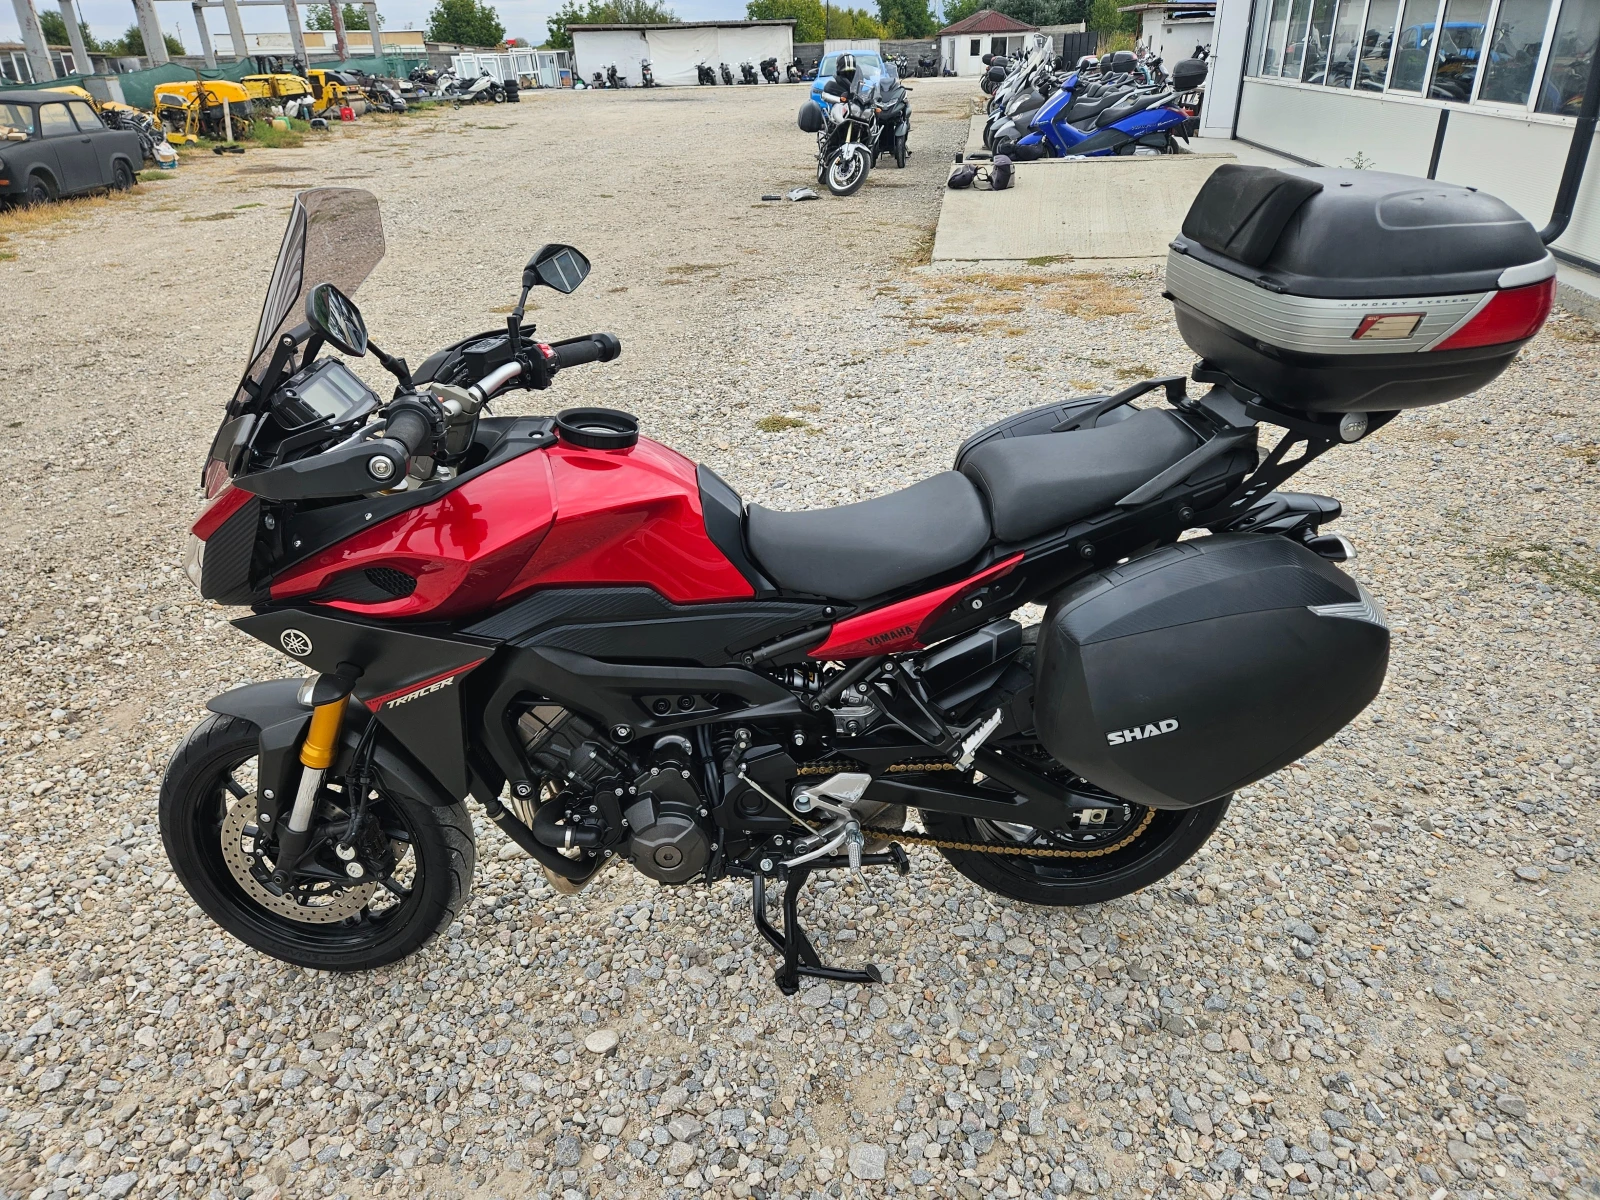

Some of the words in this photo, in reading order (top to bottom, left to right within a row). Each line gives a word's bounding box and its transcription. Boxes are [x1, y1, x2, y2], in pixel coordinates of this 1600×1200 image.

[866, 625, 914, 646] YAMAHA
[386, 676, 454, 709] TRACER
[1107, 719, 1179, 746] SHAD
